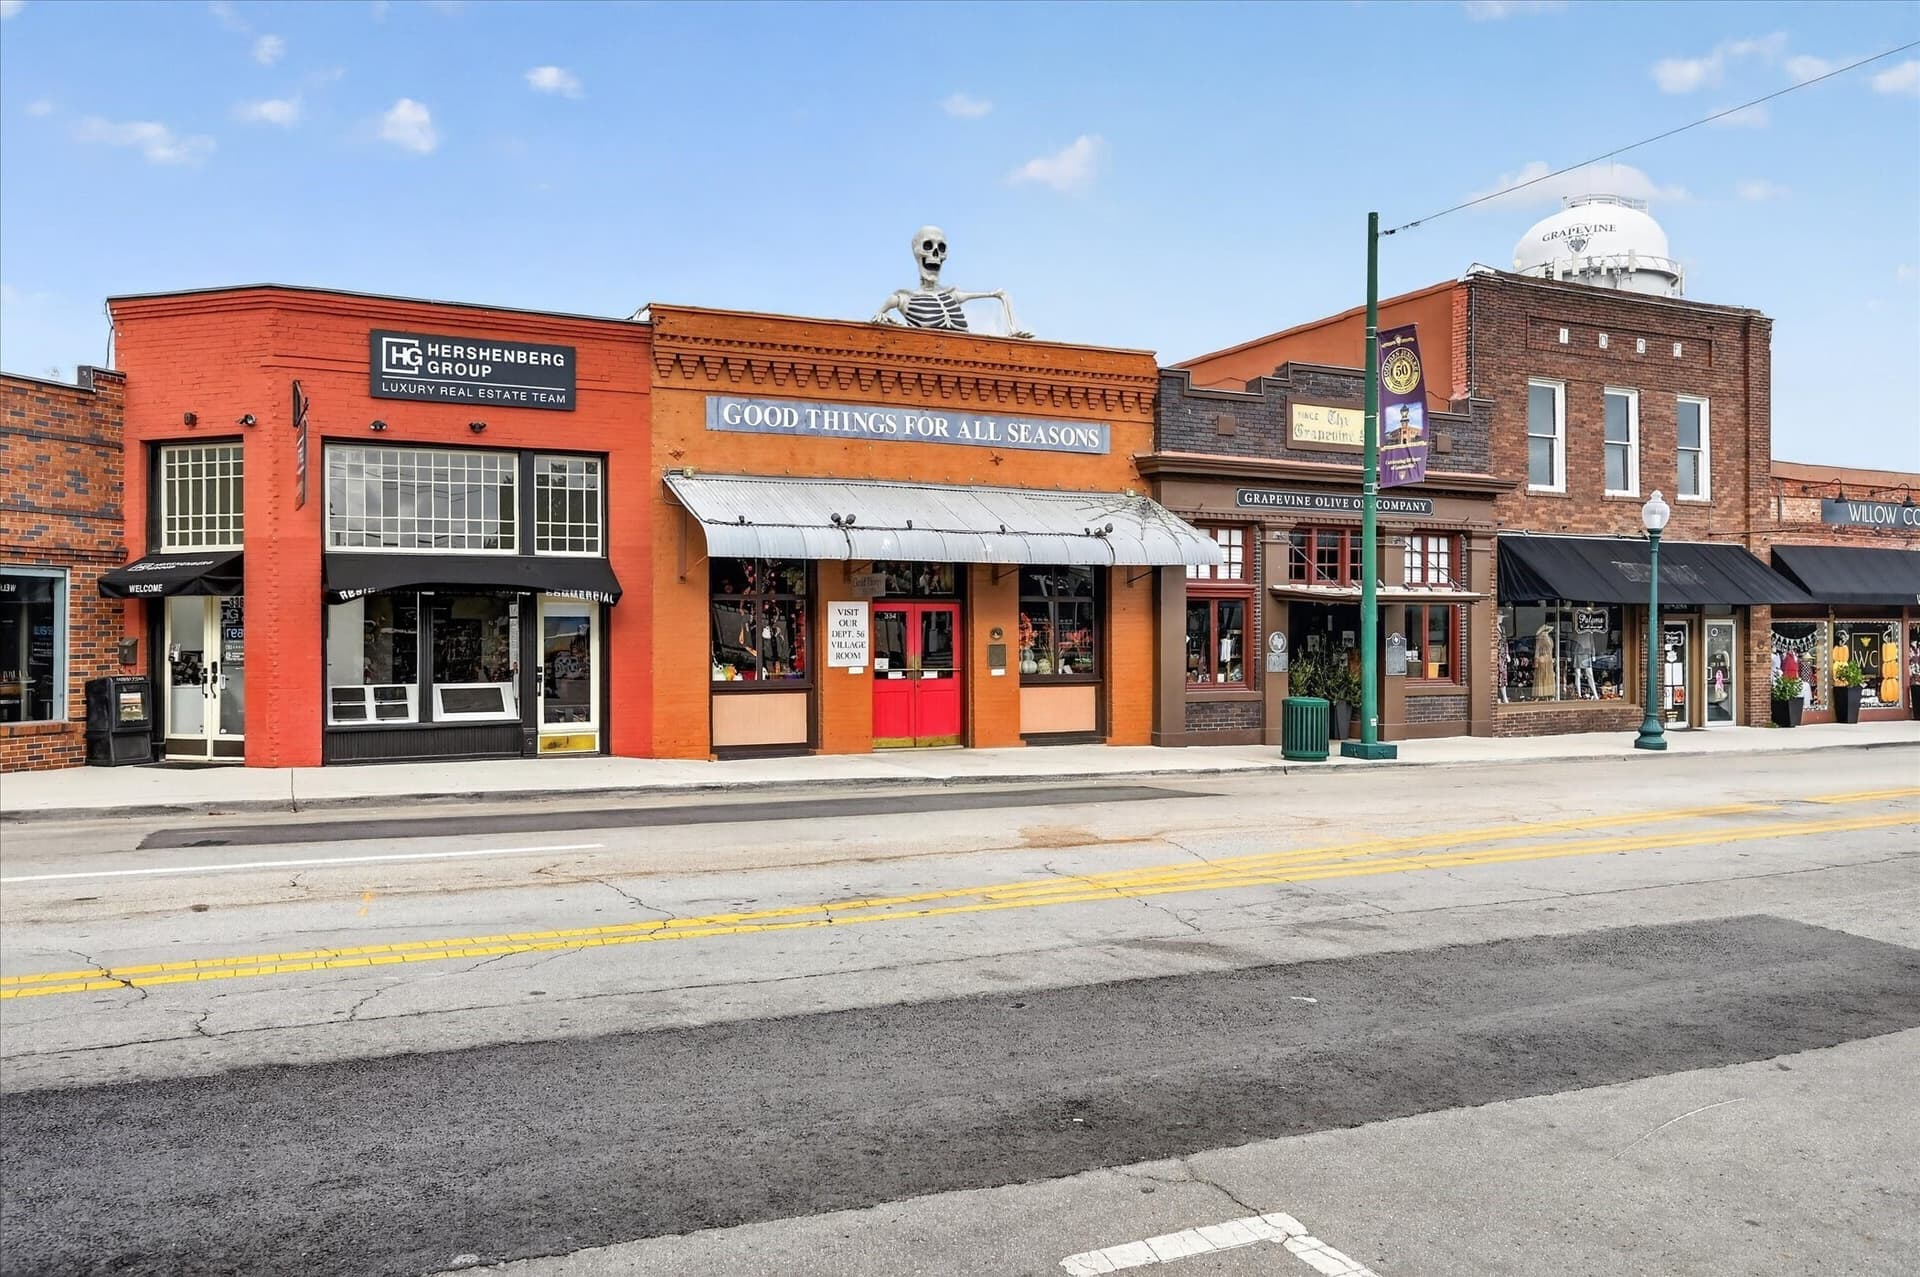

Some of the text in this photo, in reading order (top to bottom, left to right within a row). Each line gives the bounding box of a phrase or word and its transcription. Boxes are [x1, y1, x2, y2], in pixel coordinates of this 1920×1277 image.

[1542, 224, 1617, 242] GRAPEVINE
[391, 345, 423, 366] HG
[427, 343, 565, 367] HERSHENBERG
[427, 360, 492, 378] GROUP
[1395, 363, 1408, 377] 50
[382, 381, 566, 404] LUXURY REAL ESTATE TEAM
[723, 403, 1100, 448] GOOD THINGS FOR ALL SEASONS
[1244, 492, 1311, 506] GRAPEVINE
[1315, 497, 1349, 508] OLIVE
[1375, 499, 1427, 512] COMPANY
[1848, 503, 1898, 524] WILLOW
[128, 583, 163, 593] WELCOME
[837, 608, 859, 616] VISIT
[838, 619, 858, 627] OUR
[831, 630, 865, 638] DEPT. 56
[831, 641, 866, 649] VILLAGE
[835, 651, 861, 660] ROOM
[1854, 650, 1878, 668] WC
